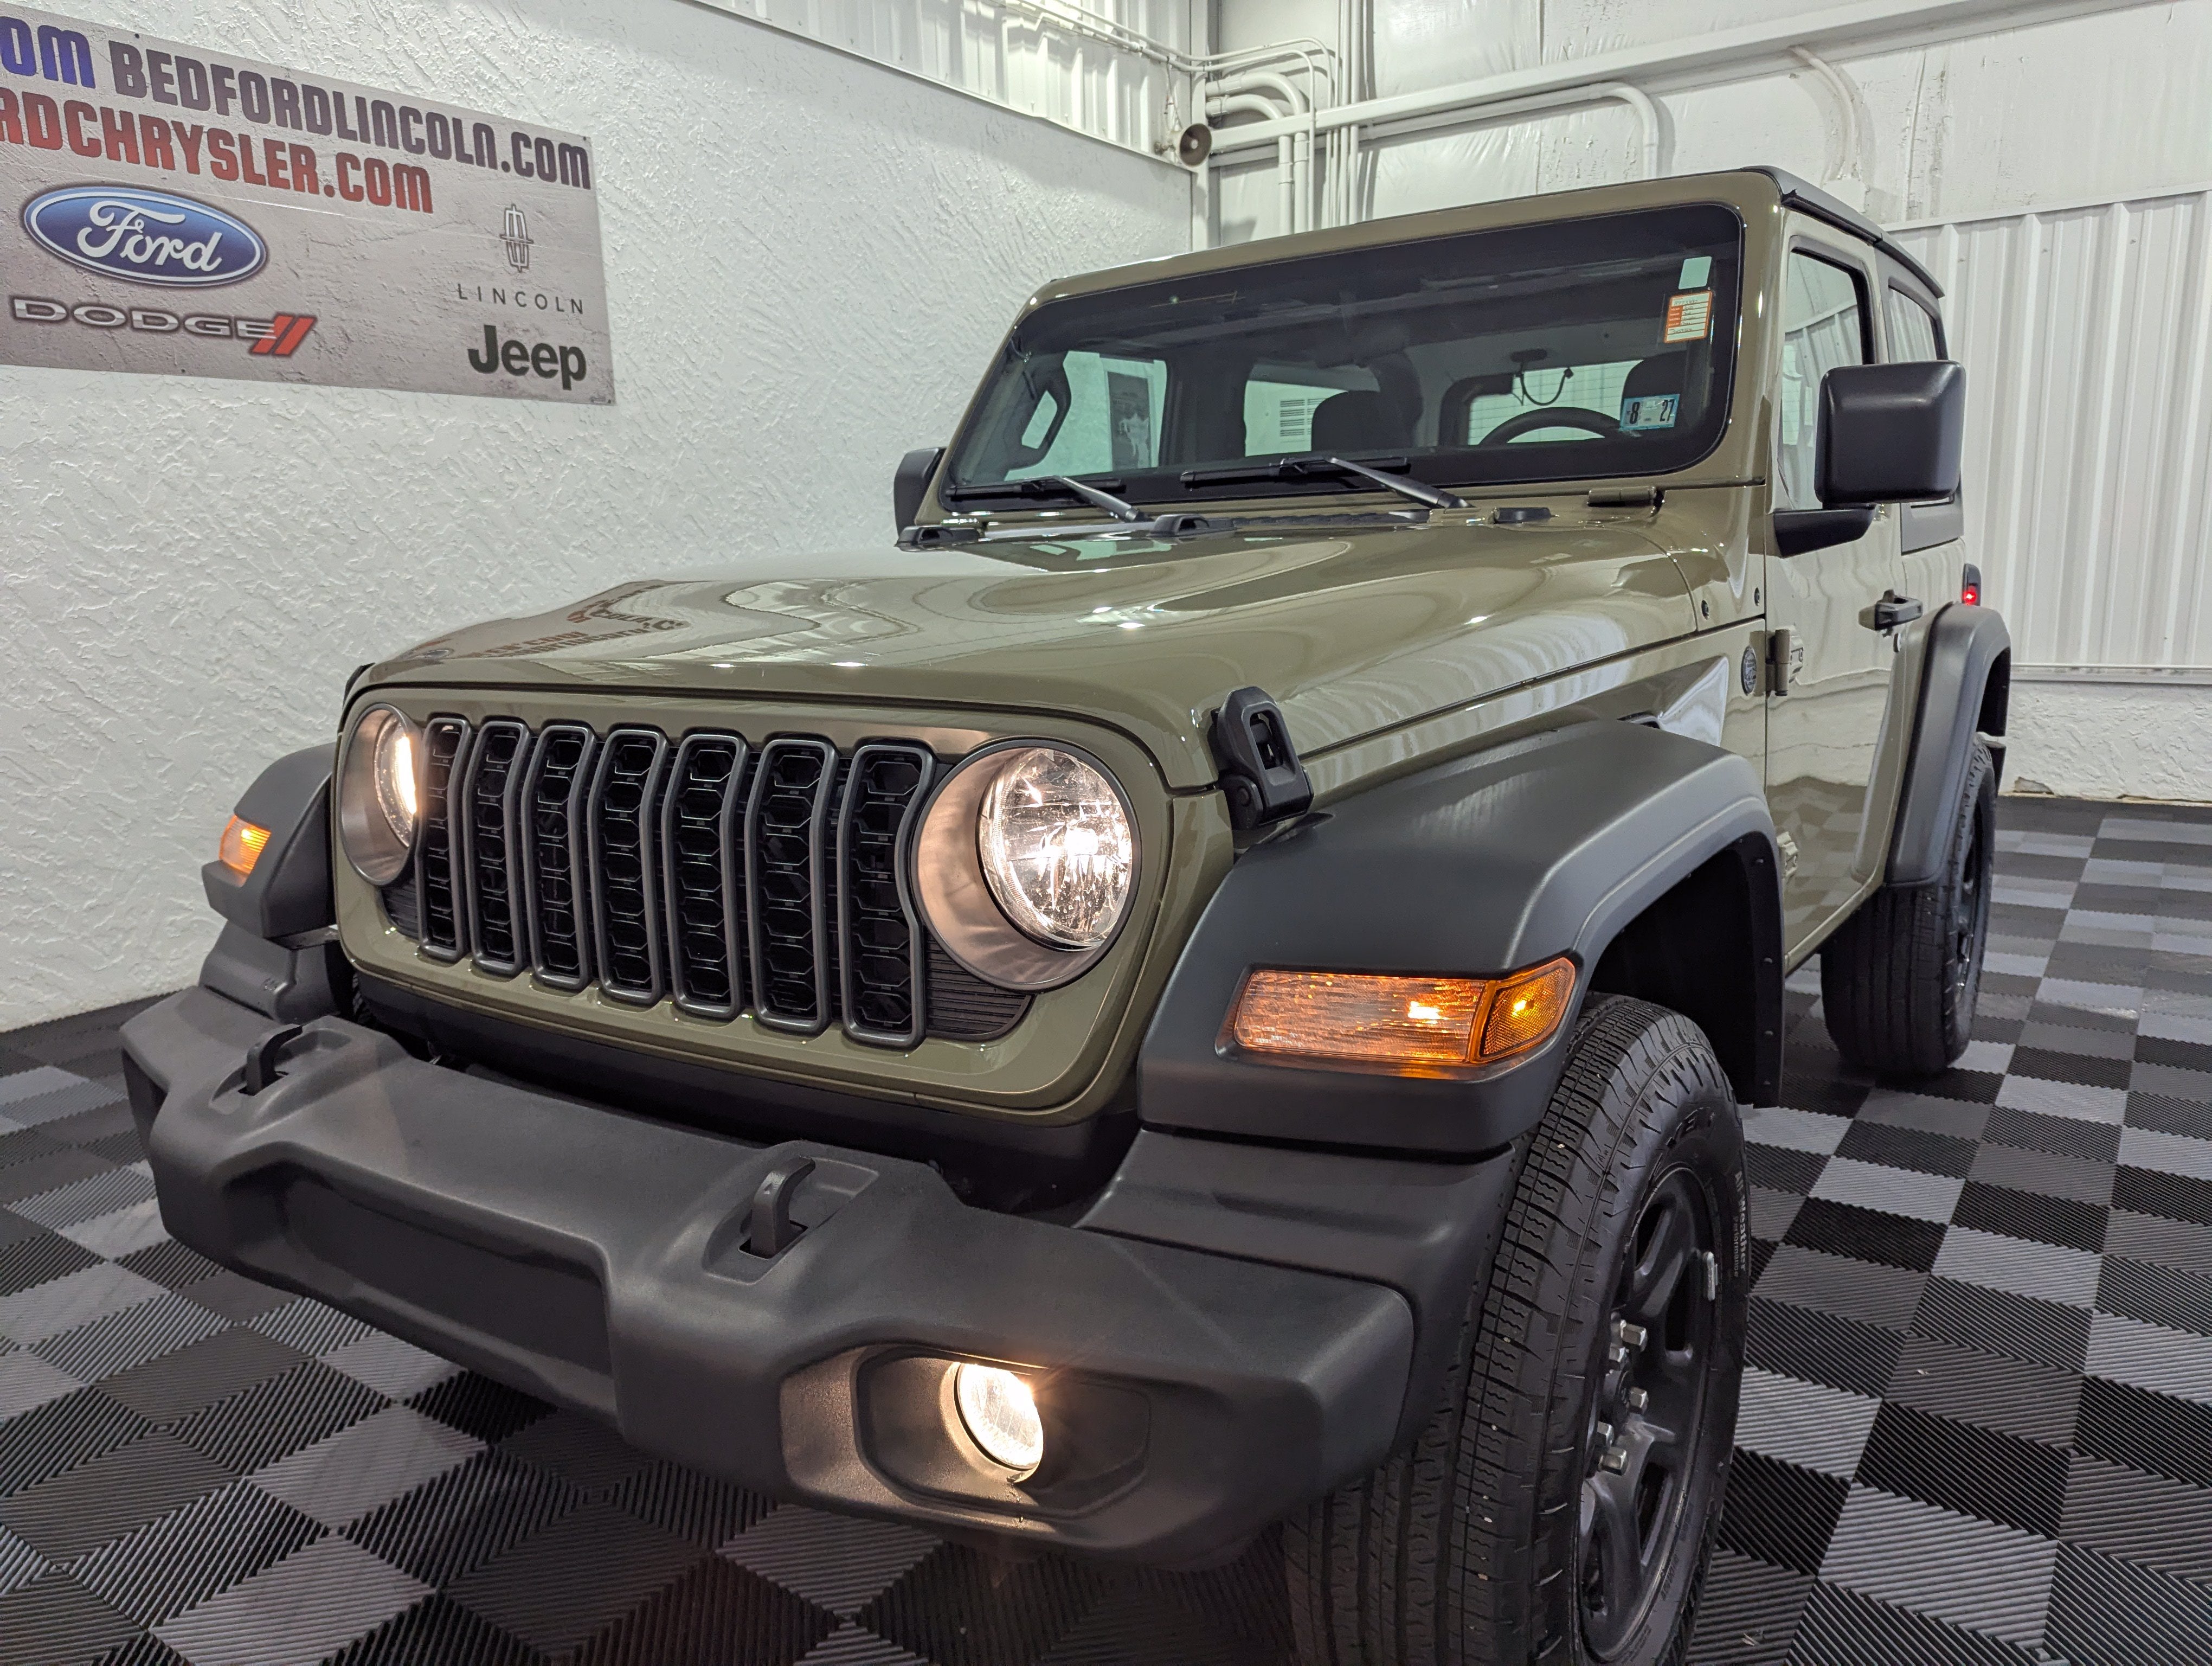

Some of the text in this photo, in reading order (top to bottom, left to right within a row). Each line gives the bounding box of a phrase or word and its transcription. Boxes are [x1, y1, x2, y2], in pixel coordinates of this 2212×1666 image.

[108, 40, 591, 190] BEDFORDLINCOLN.COM
[78, 198, 223, 273] Ford
[12, 298, 277, 341] DODGE
[458, 283, 583, 315] LINCOLN
[467, 325, 587, 390] Jeep
[1629, 401, 1640, 424] 8
[1660, 399, 1675, 422] 27
